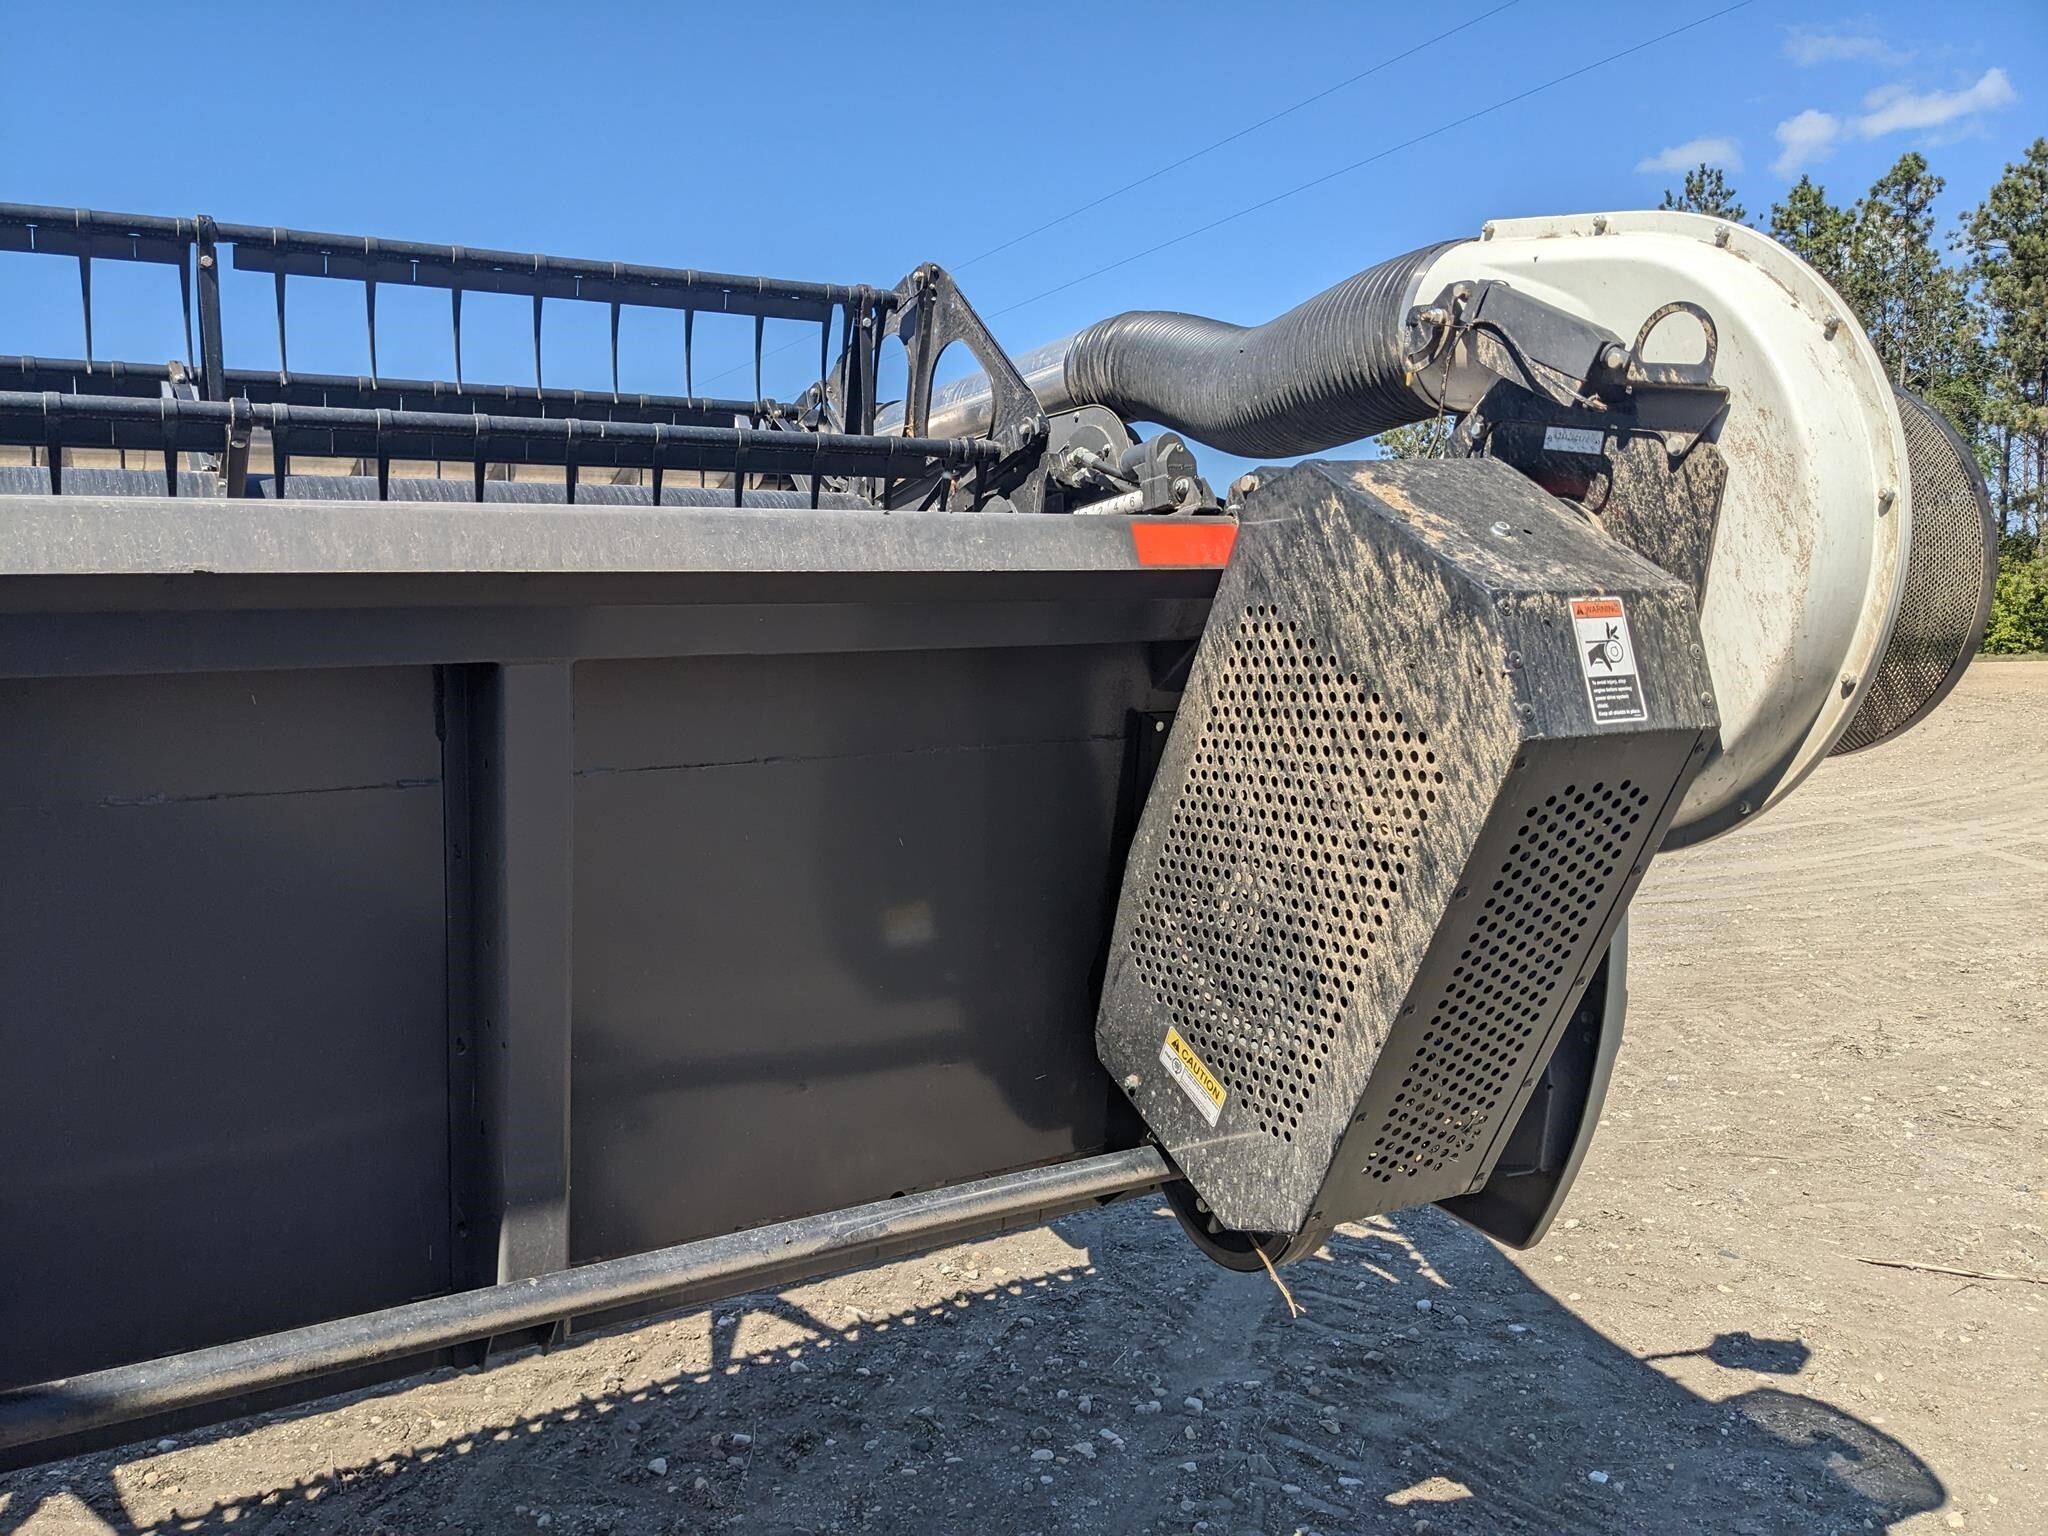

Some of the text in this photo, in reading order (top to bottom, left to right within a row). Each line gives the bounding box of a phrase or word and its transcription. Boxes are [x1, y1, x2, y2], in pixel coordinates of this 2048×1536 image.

[1113, 502, 1119, 512] 4
[1129, 496, 1135, 507] 6
[1585, 604, 1620, 614] WARNING
[1181, 1049, 1220, 1099] CAUTION
